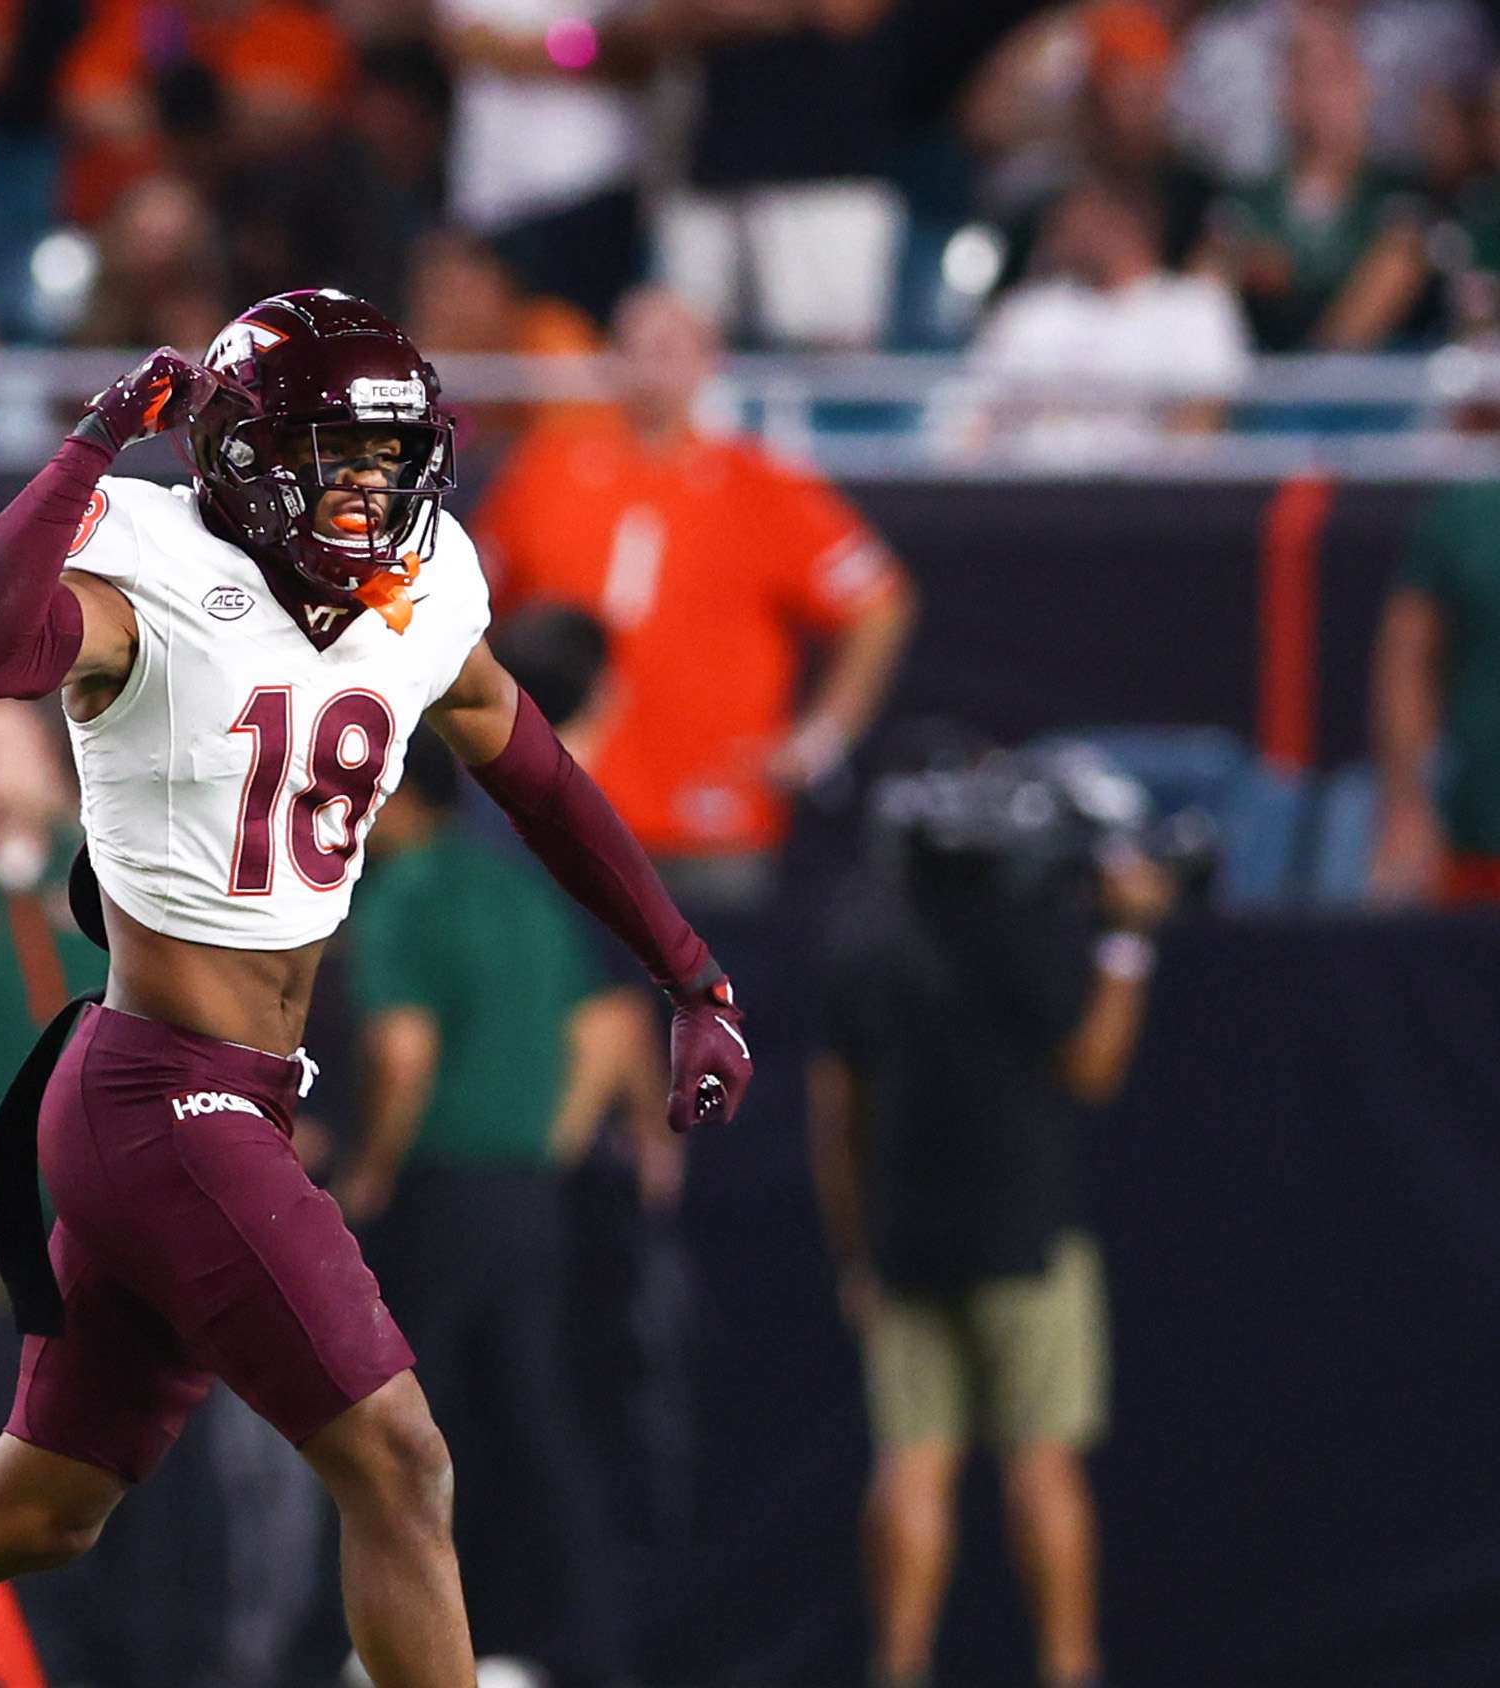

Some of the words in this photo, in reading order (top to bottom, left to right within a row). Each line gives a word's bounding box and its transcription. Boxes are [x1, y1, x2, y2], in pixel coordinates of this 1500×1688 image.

[371, 386, 408, 398] TECH
[211, 594, 245, 607] ACC
[303, 603, 348, 633] VT
[227, 685, 396, 896] 18
